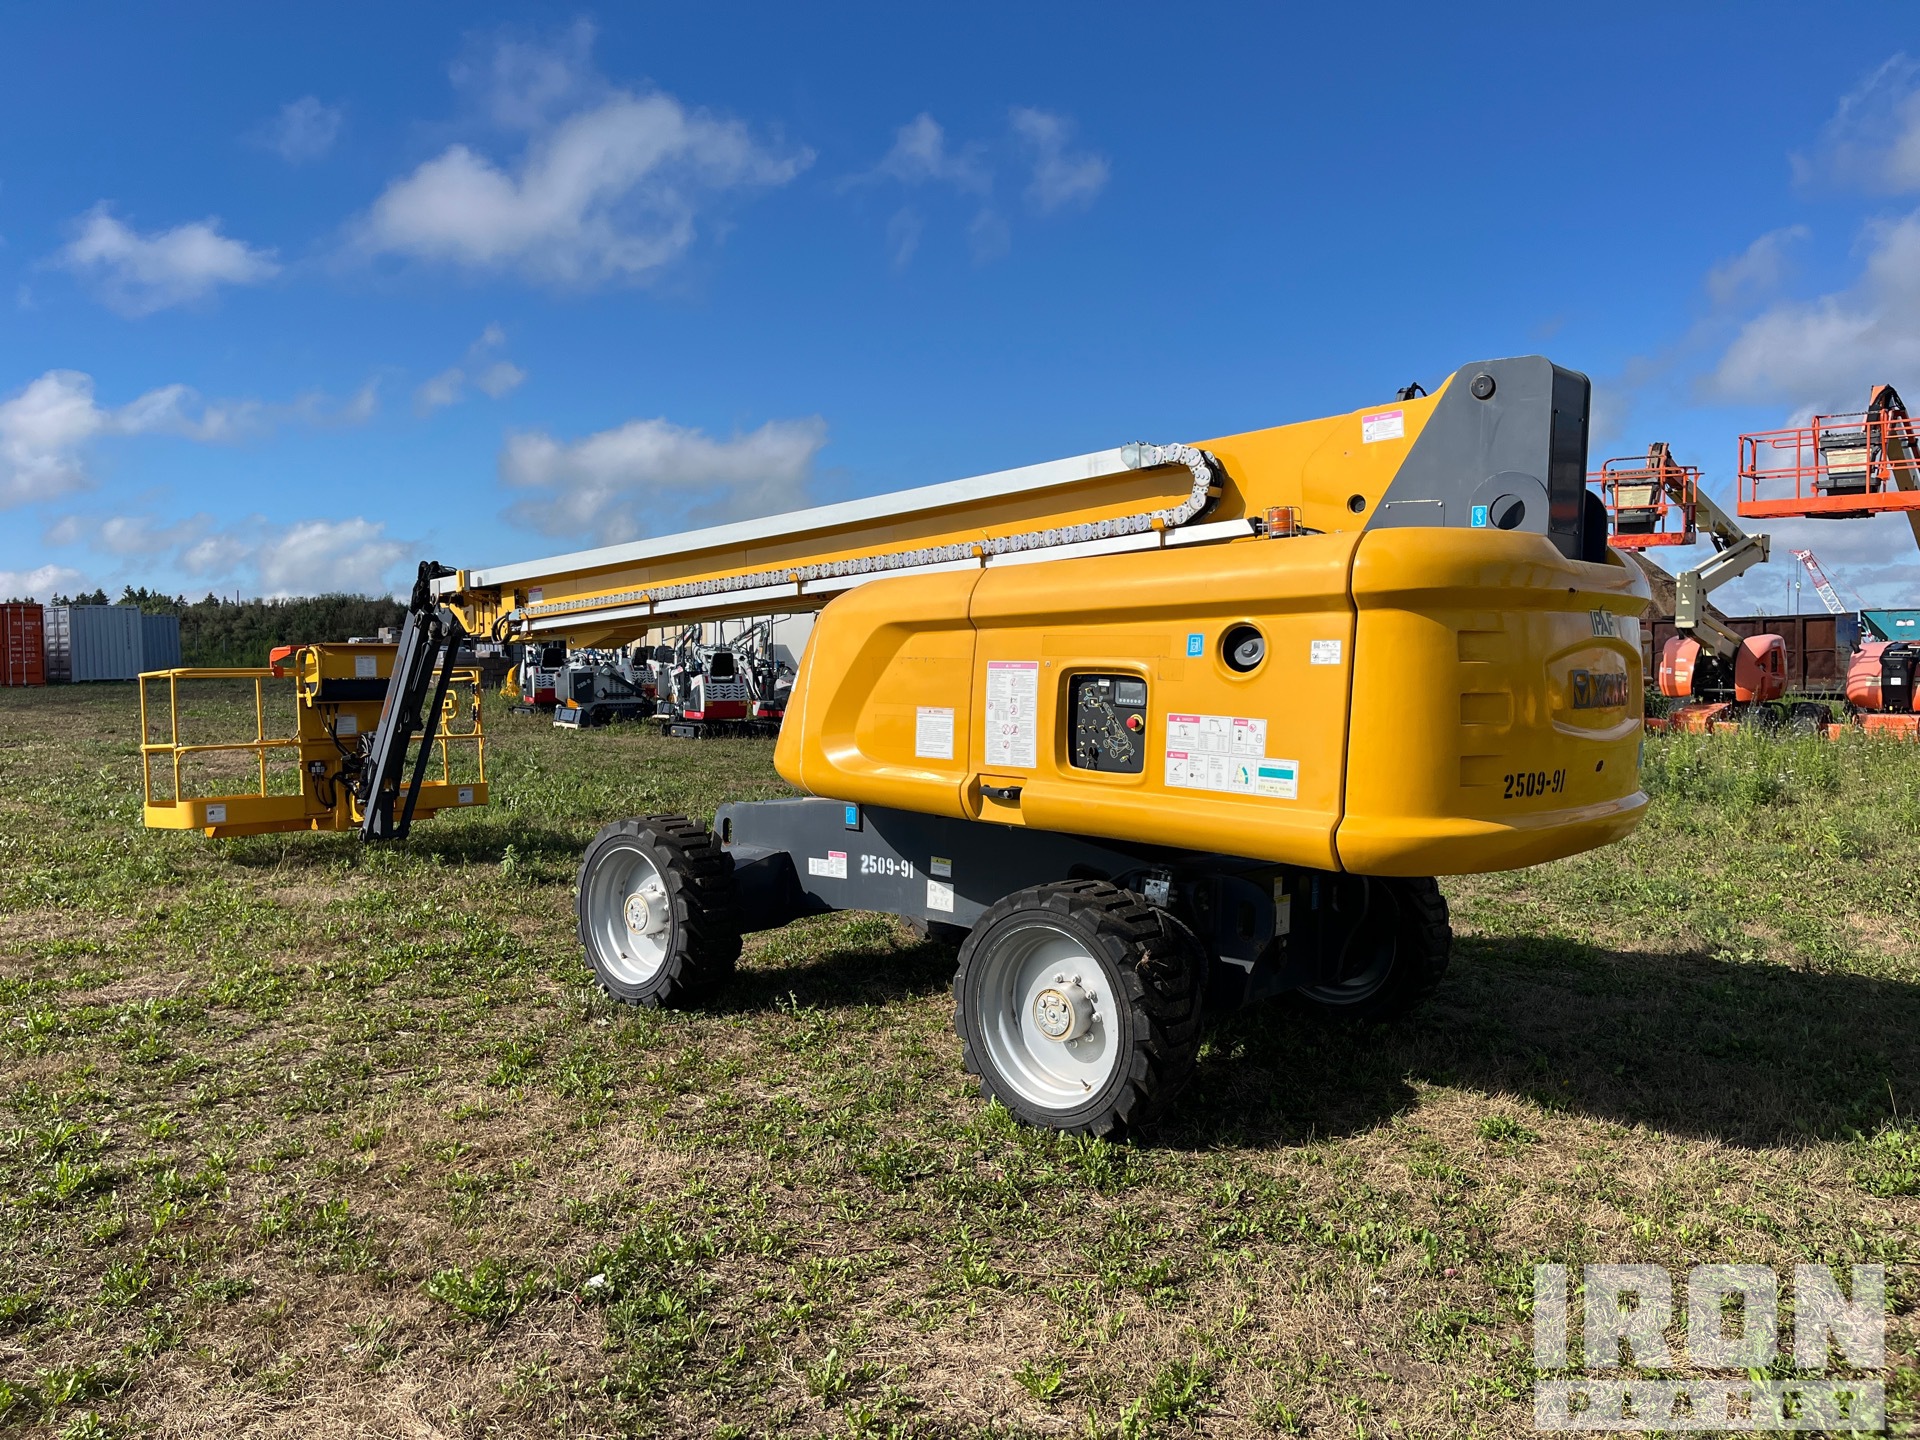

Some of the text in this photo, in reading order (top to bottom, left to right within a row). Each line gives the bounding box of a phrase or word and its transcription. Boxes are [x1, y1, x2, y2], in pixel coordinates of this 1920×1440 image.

[1590, 605, 1614, 635] IPAF
[1503, 768, 1566, 800] 2509-91
[860, 854, 914, 879] 2509-91
